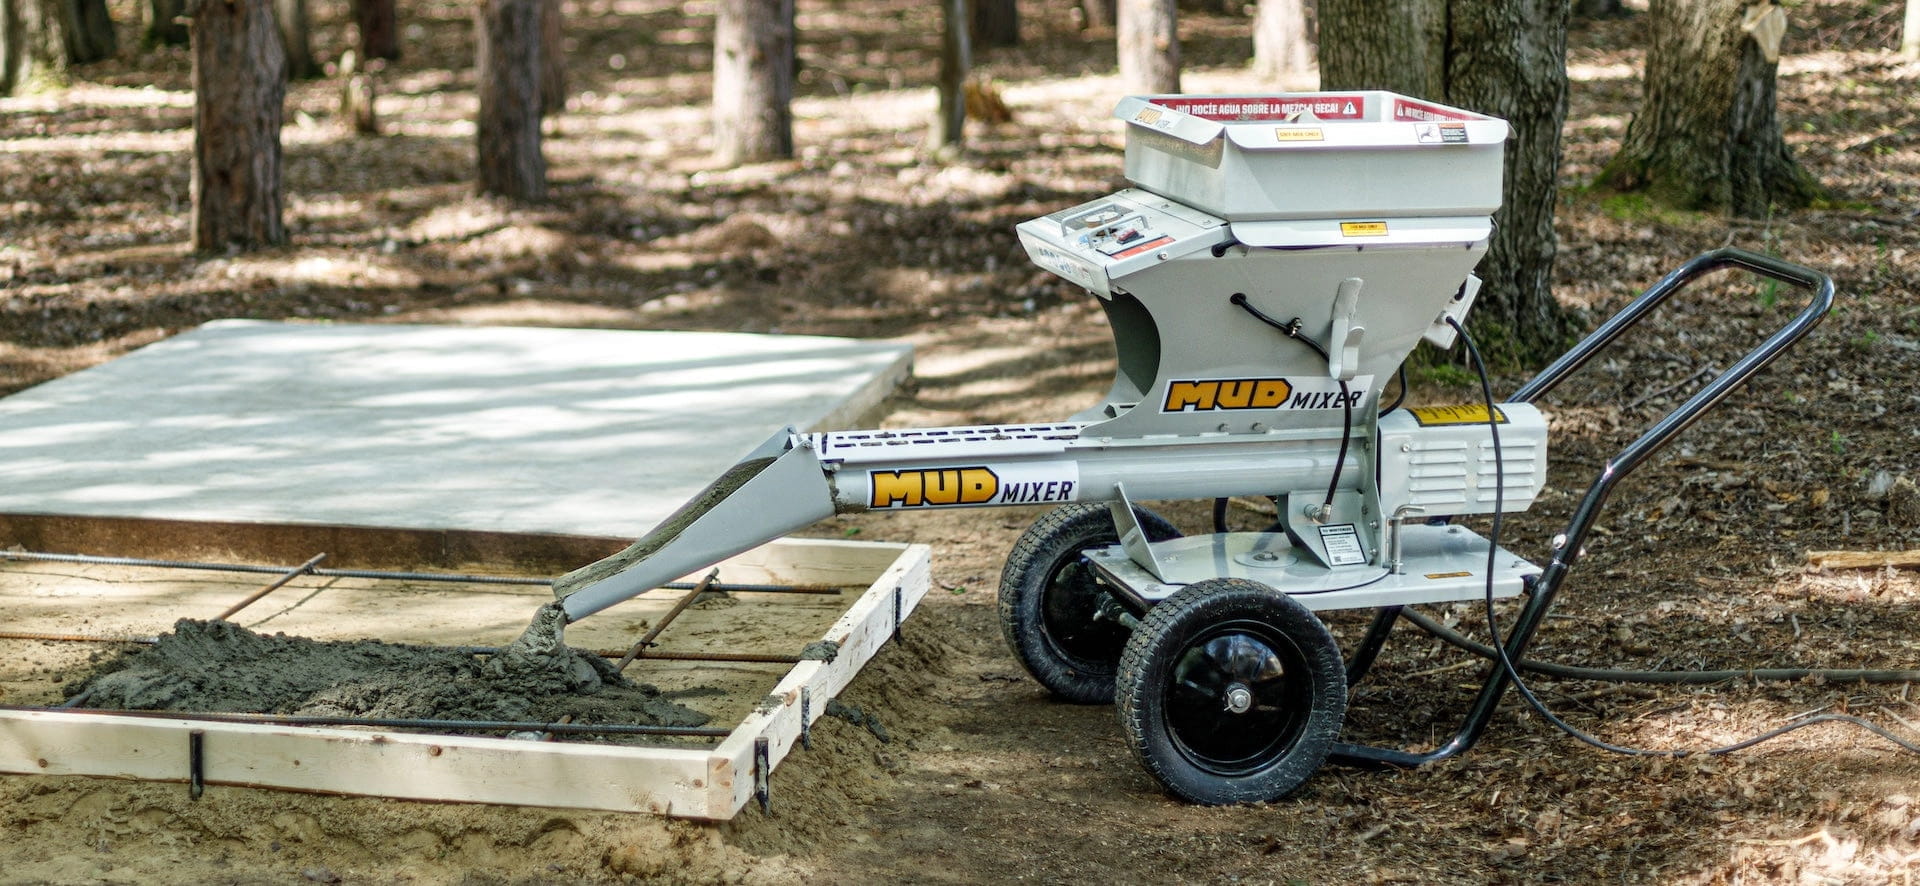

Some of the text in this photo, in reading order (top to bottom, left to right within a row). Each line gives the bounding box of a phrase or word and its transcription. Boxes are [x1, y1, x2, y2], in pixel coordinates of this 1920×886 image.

[1191, 102, 1218, 115] ROCÍE
[1219, 104, 1240, 115] AGUA
[1242, 103, 1269, 114] SOBRE
[1270, 103, 1280, 114] LA
[1314, 103, 1338, 114] SECA!
[1163, 378, 1363, 412] MUD MIXER
[870, 466, 1073, 508] MUD MIXER
